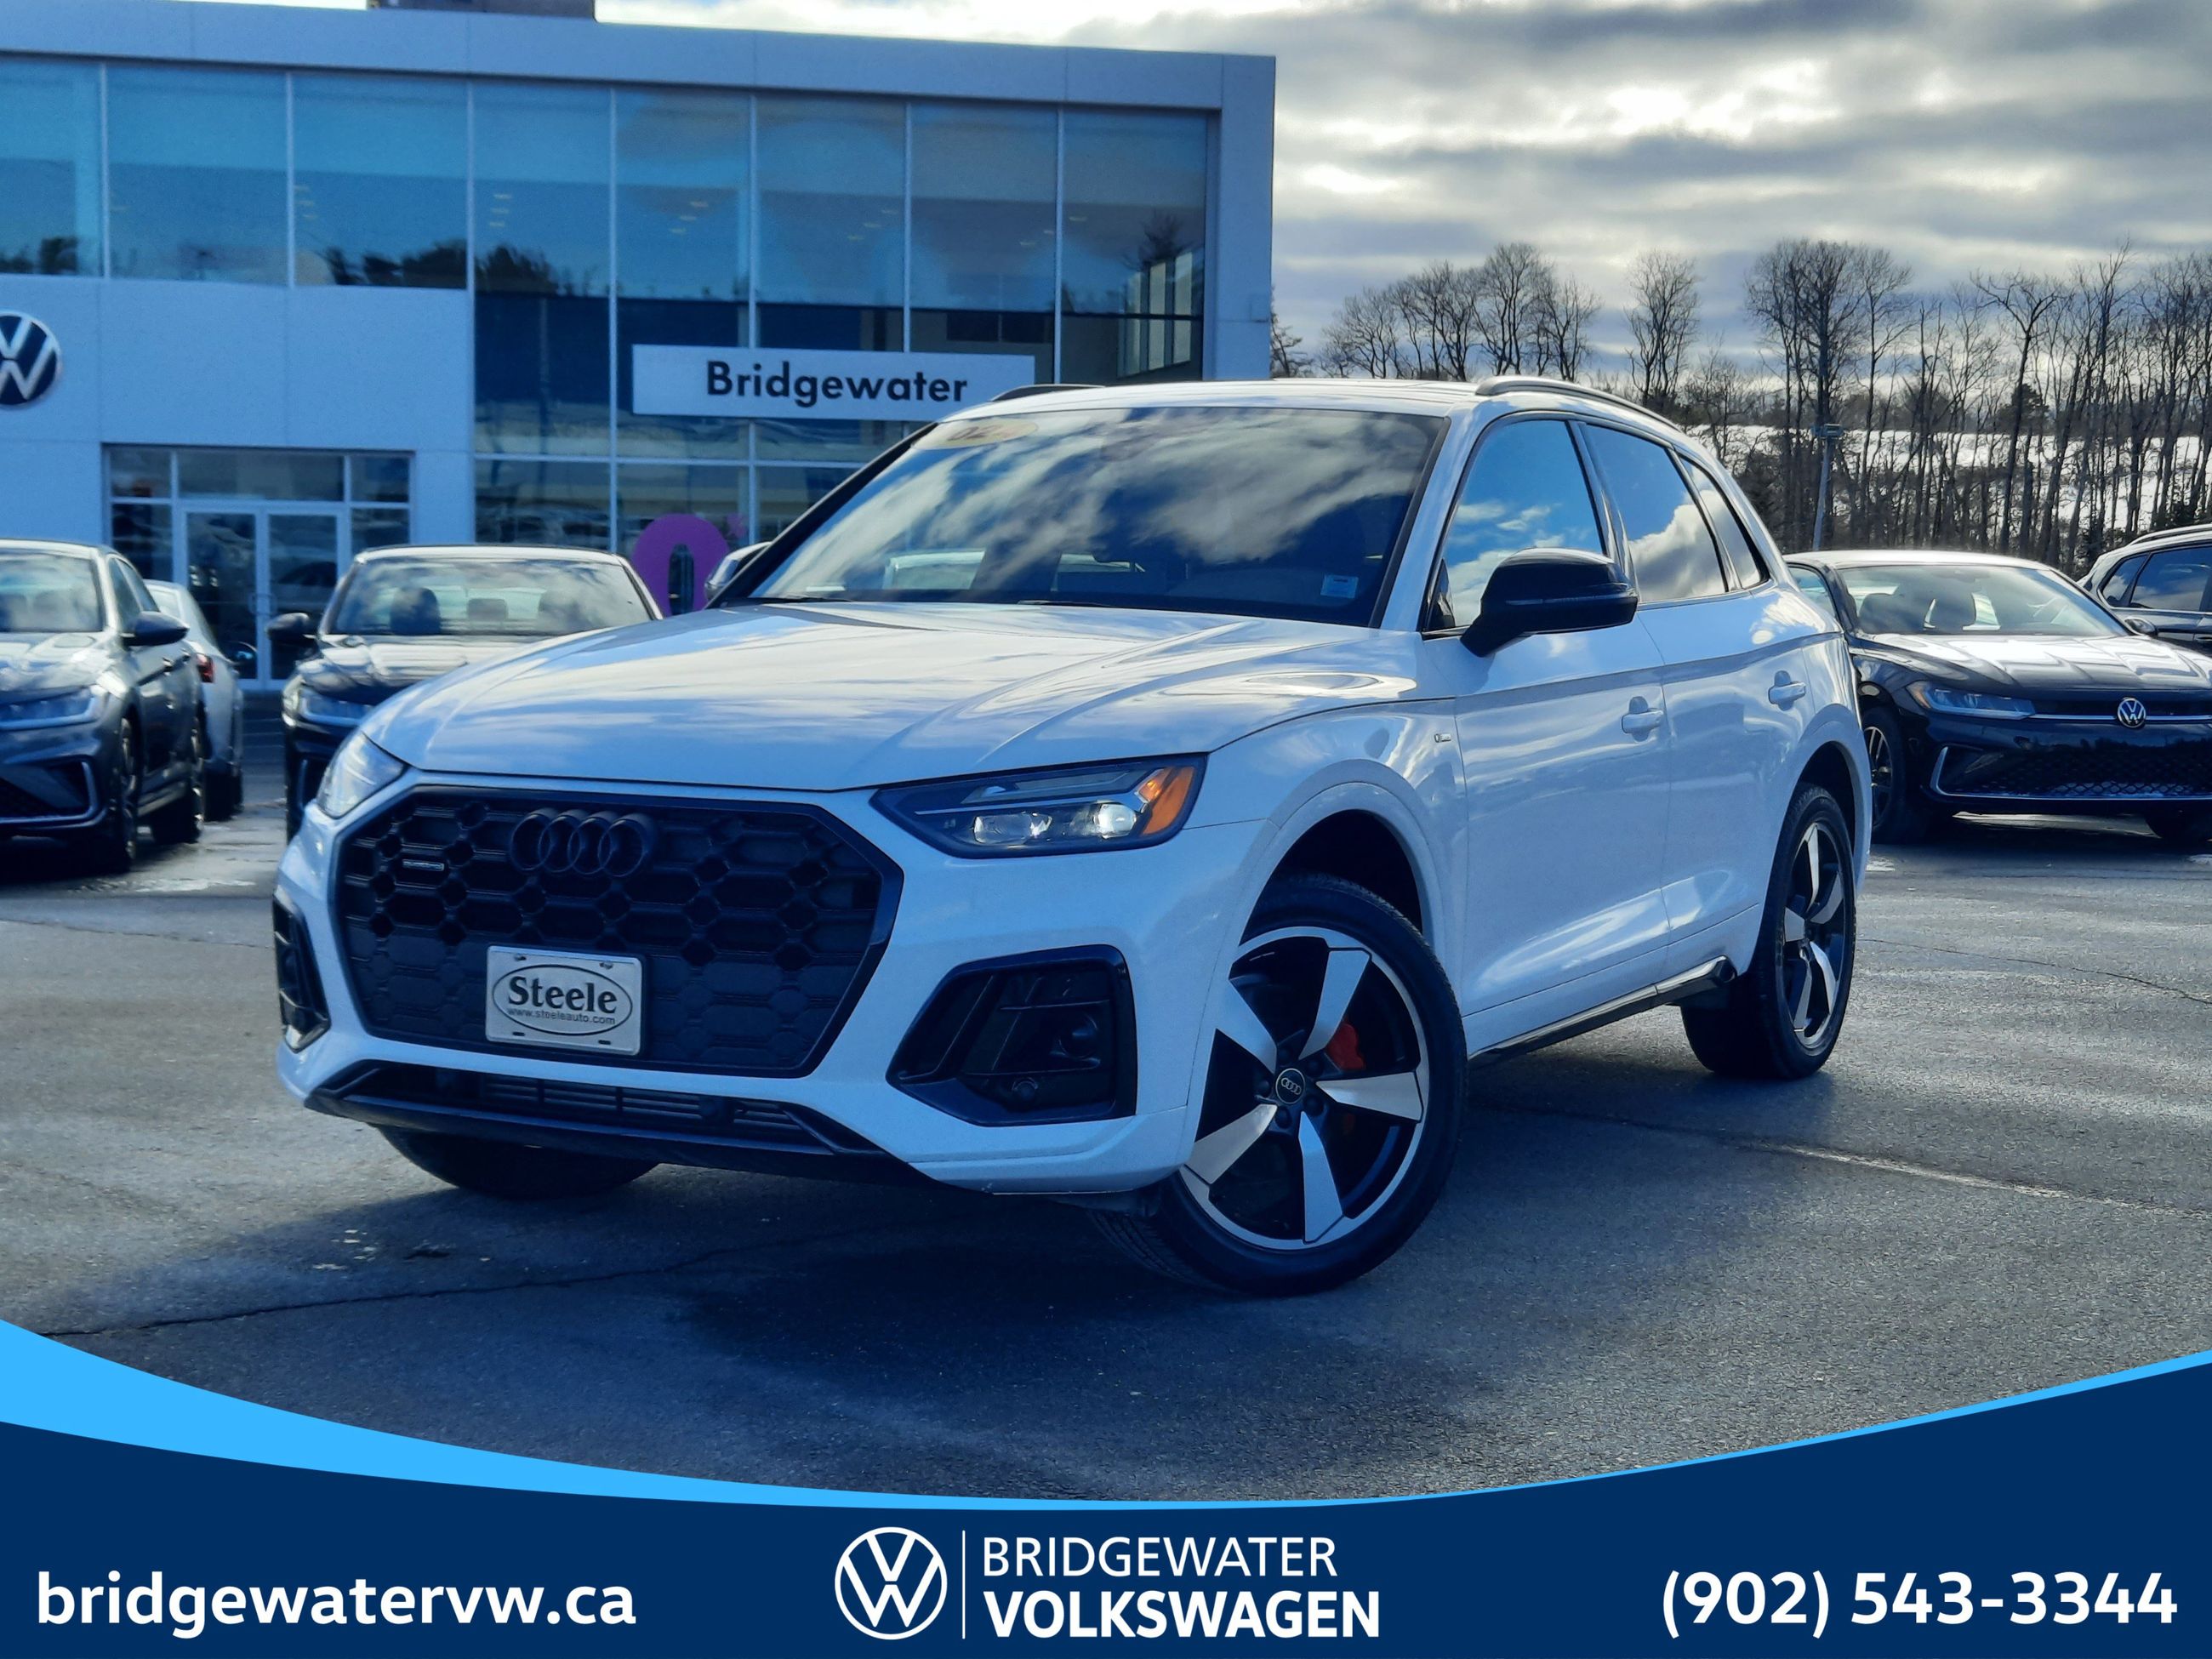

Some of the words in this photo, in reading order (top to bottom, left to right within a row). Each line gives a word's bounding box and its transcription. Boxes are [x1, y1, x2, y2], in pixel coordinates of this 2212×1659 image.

[706, 360, 968, 408] Bridgewater
[508, 975, 618, 1015] Steele
[506, 1007, 616, 1025] www.steeleauto.com
